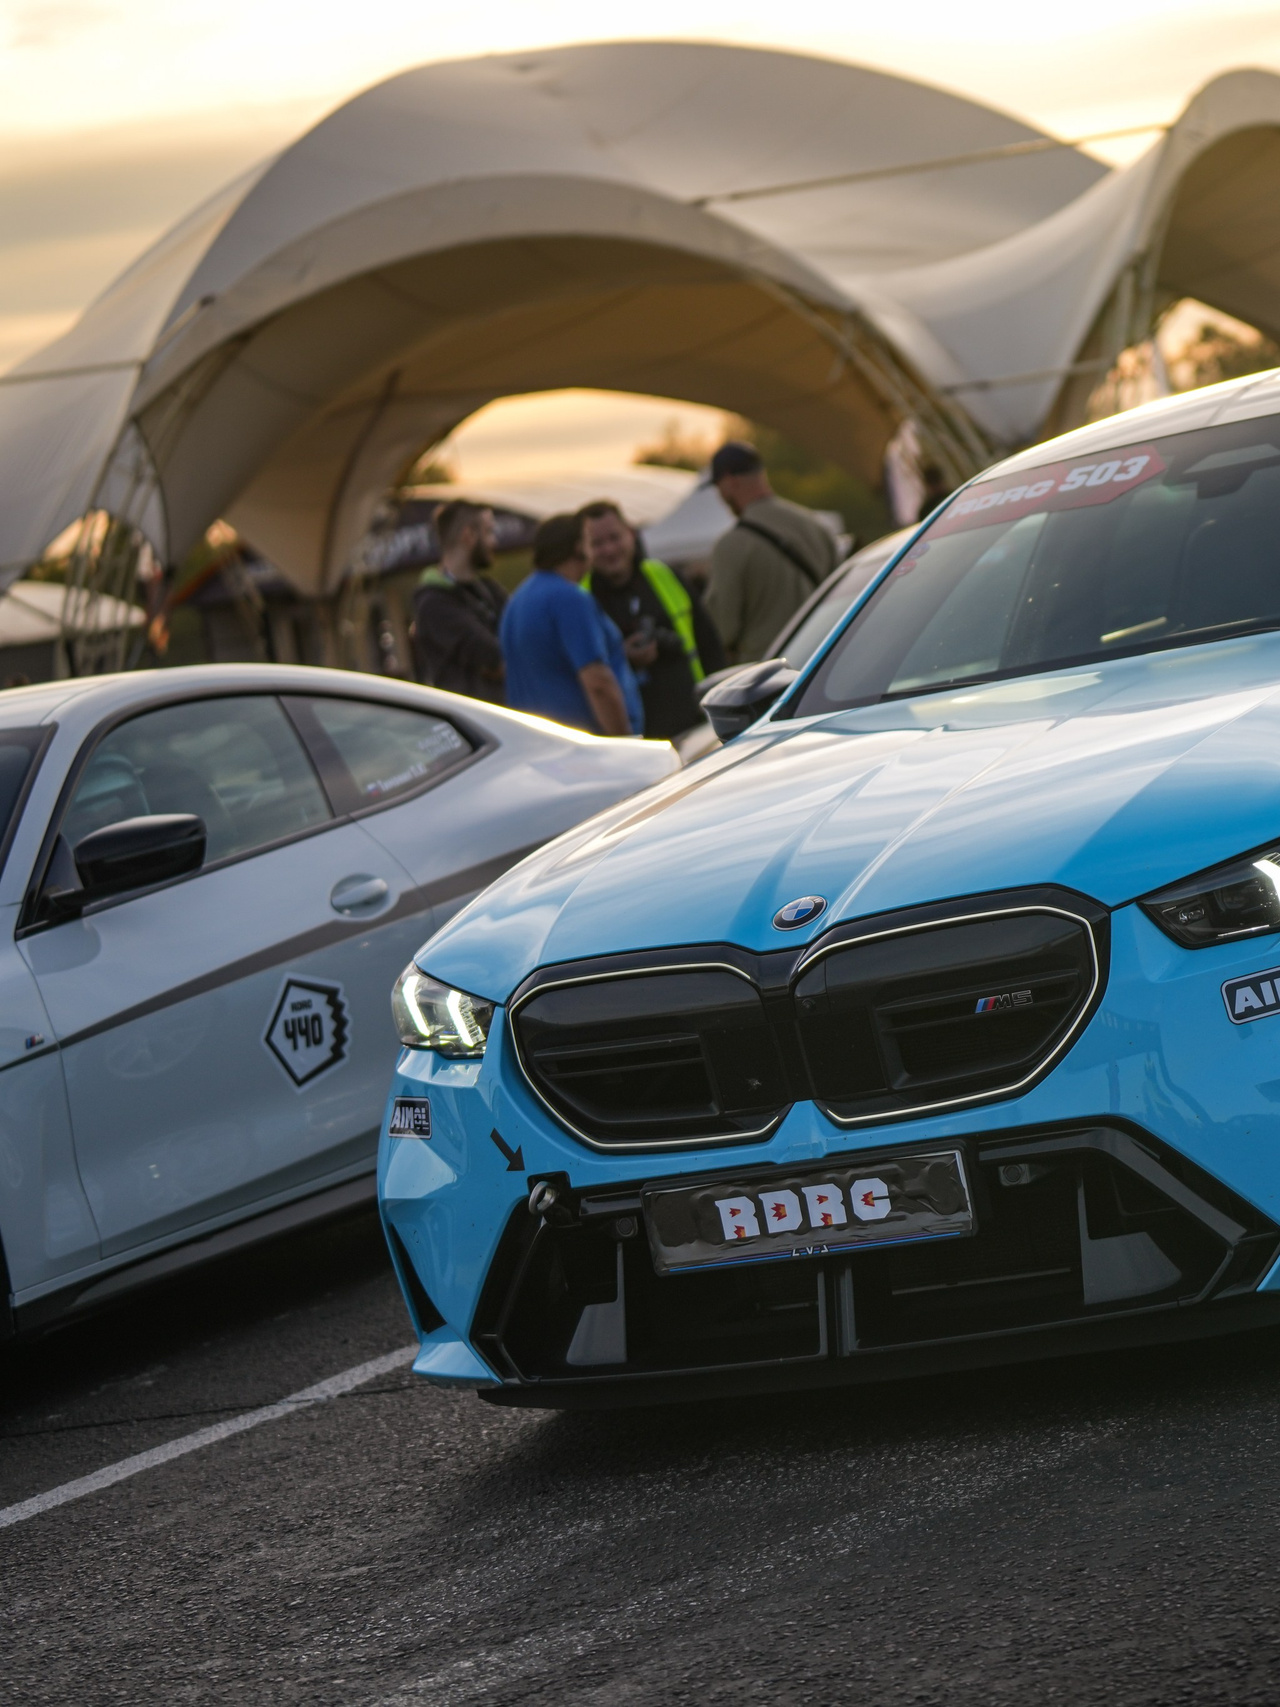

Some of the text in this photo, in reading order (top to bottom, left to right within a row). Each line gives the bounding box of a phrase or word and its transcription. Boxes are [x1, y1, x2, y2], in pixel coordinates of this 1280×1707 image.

[1058, 455, 1150, 492] 503
[976, 989, 1034, 1013] M5
[284, 1012, 324, 1051] 440
[391, 1106, 429, 1131] AIMOL
[715, 1177, 892, 1241] RDRC
